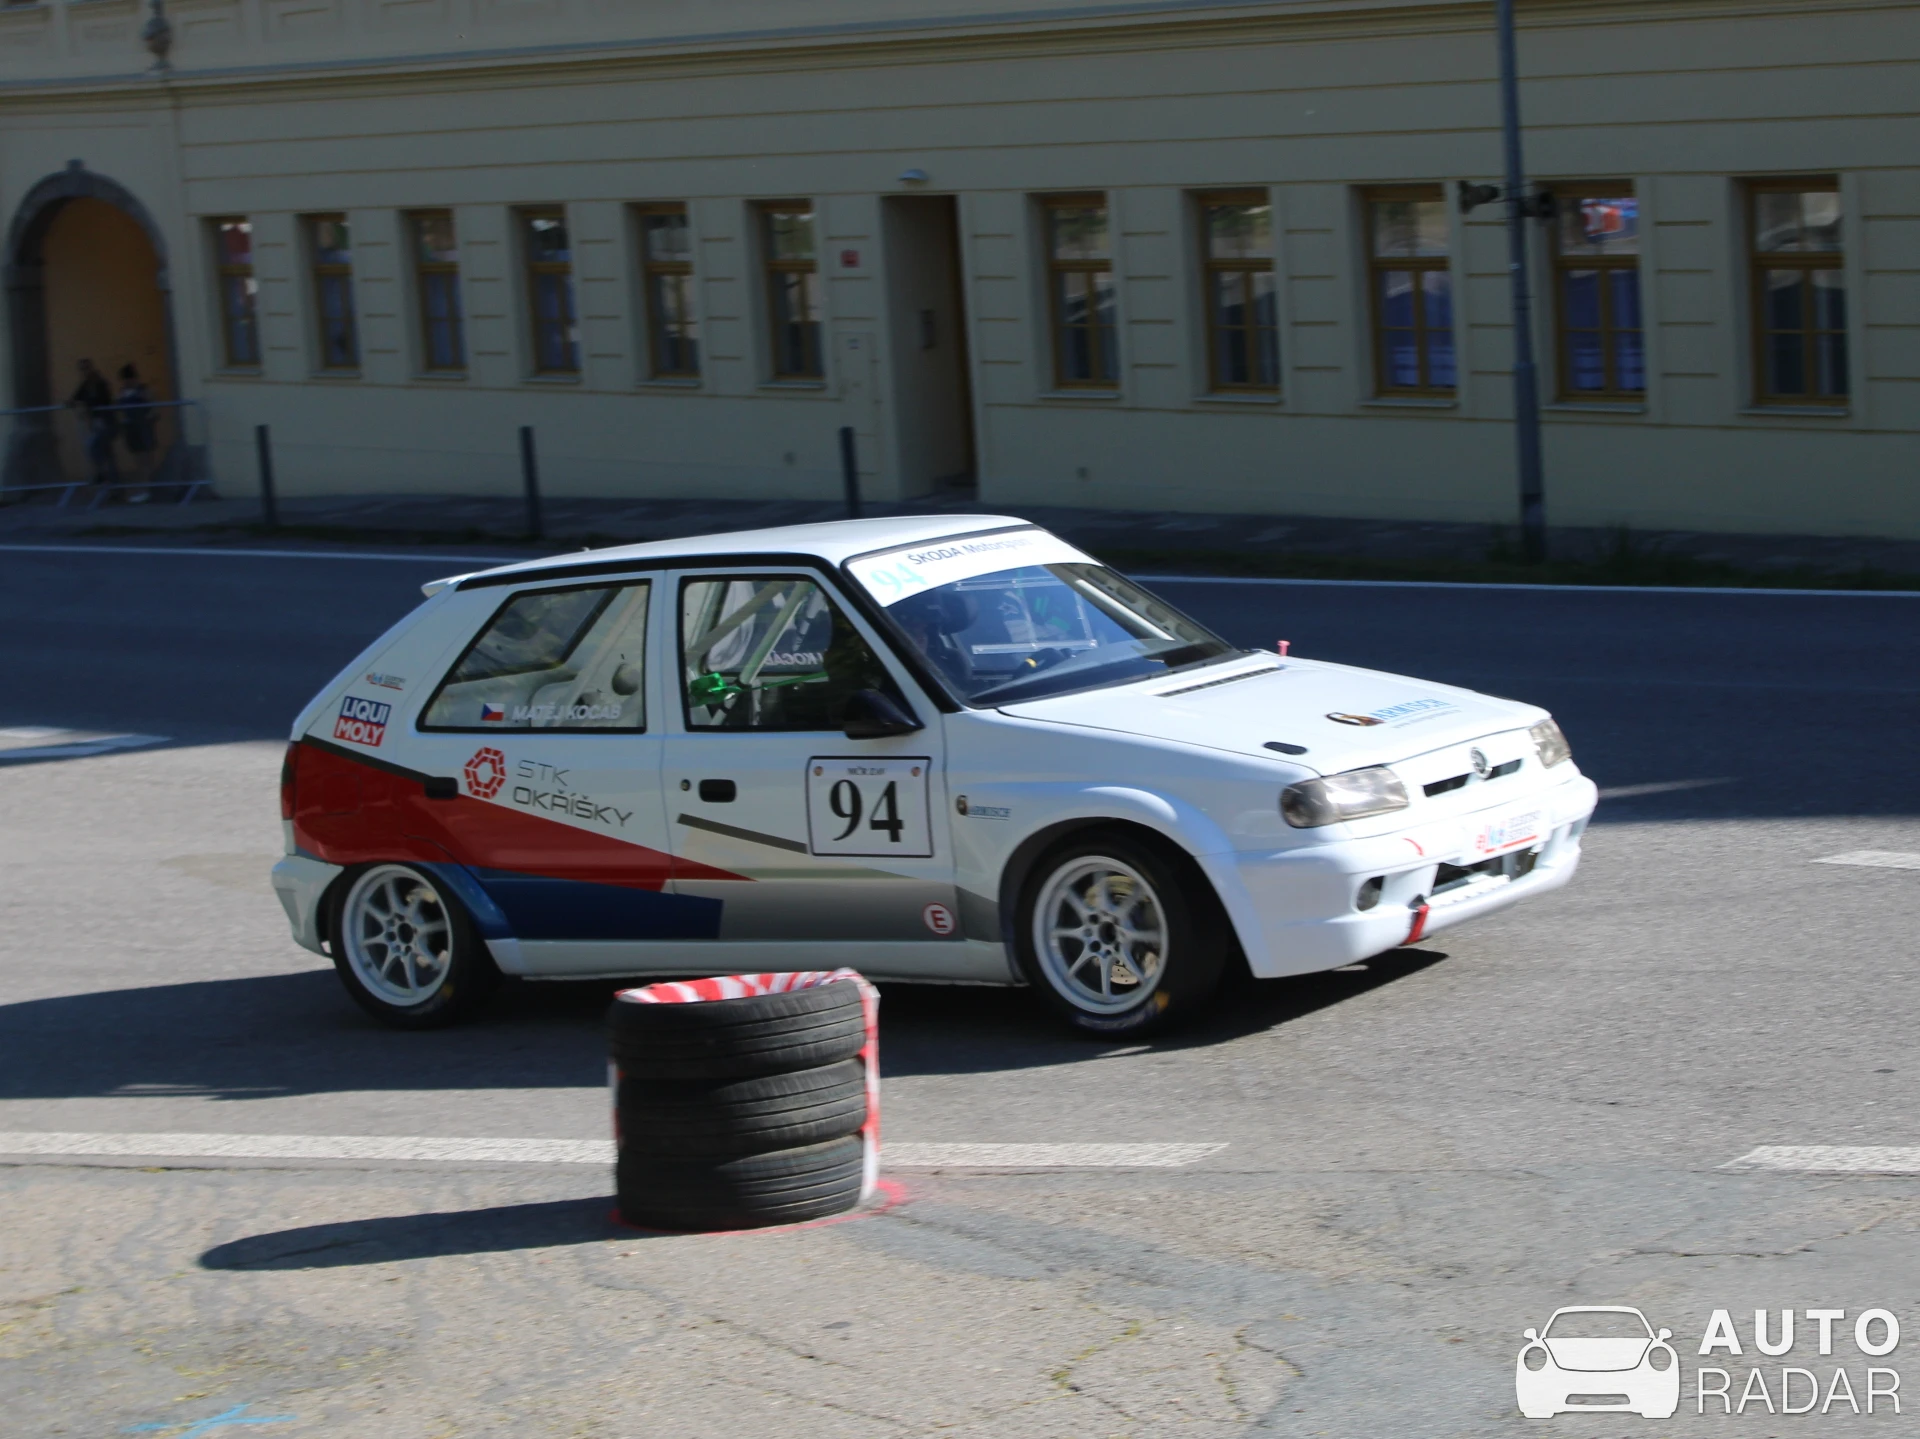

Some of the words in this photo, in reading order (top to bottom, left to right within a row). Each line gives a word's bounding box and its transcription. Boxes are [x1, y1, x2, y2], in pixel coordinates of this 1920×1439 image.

[907, 547, 964, 565] ŠKODA
[870, 562, 929, 596] 94
[341, 698, 389, 724] LIQUI
[335, 719, 384, 744] MOLY
[517, 759, 570, 787] STK
[513, 788, 633, 827] OKŘÍŠKY
[829, 779, 904, 843] 94
[930, 910, 949, 929] E
